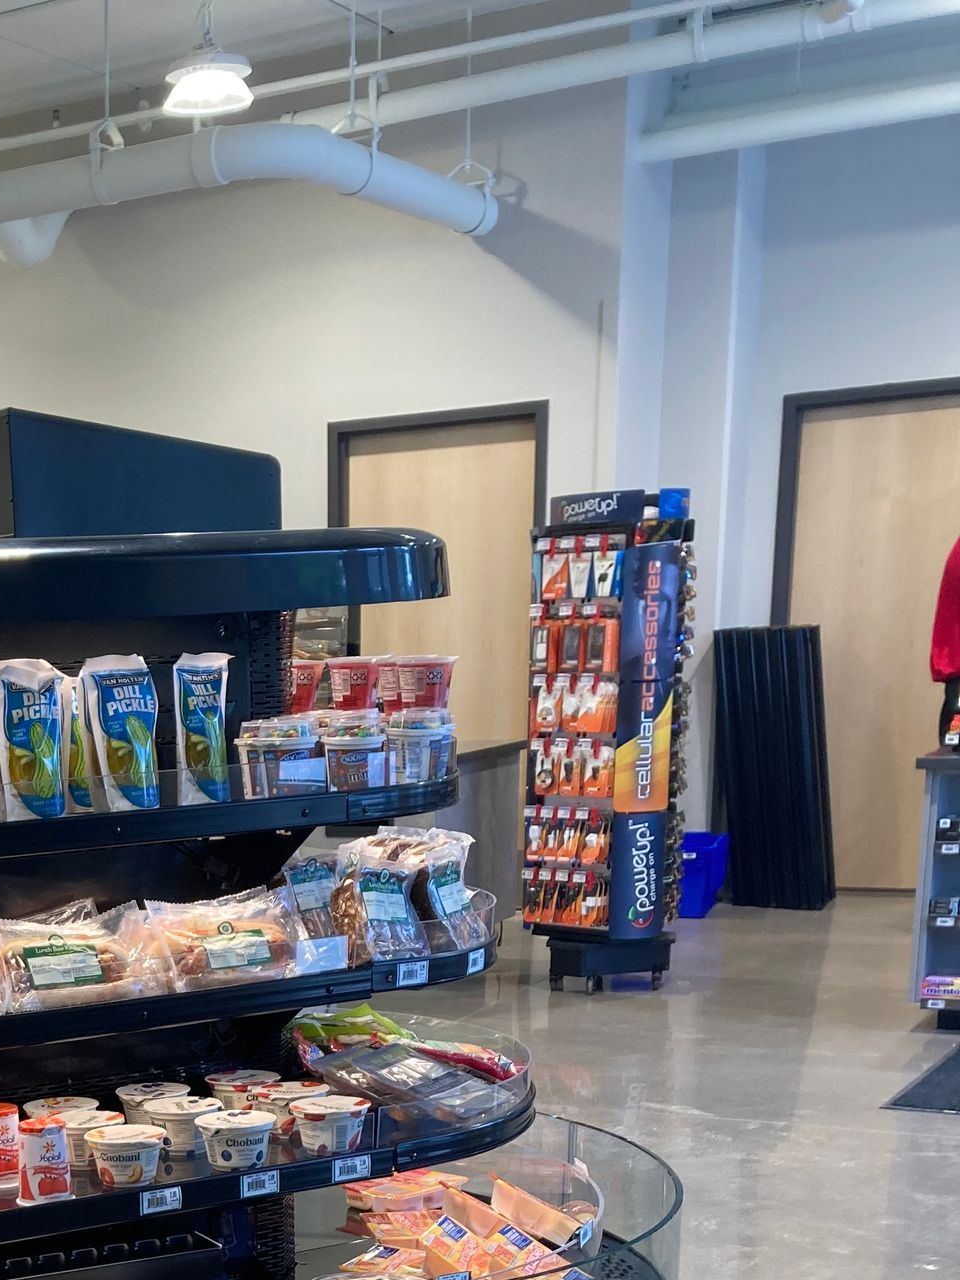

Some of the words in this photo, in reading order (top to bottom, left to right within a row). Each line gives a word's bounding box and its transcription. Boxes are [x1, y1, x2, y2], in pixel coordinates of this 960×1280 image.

[642, 560, 661, 712] accessories
[102, 677, 117, 685] VAN
[113, 685, 143, 700] DILL
[191, 684, 217, 695] DILL
[106, 699, 155, 716] PICKLE
[637, 710, 654, 800] cellular
[648, 852, 655, 865] on
[629, 822, 655, 912] powerup!
[225, 1135, 265, 1148] Chobani
[100, 1151, 141, 1163] Chobani
